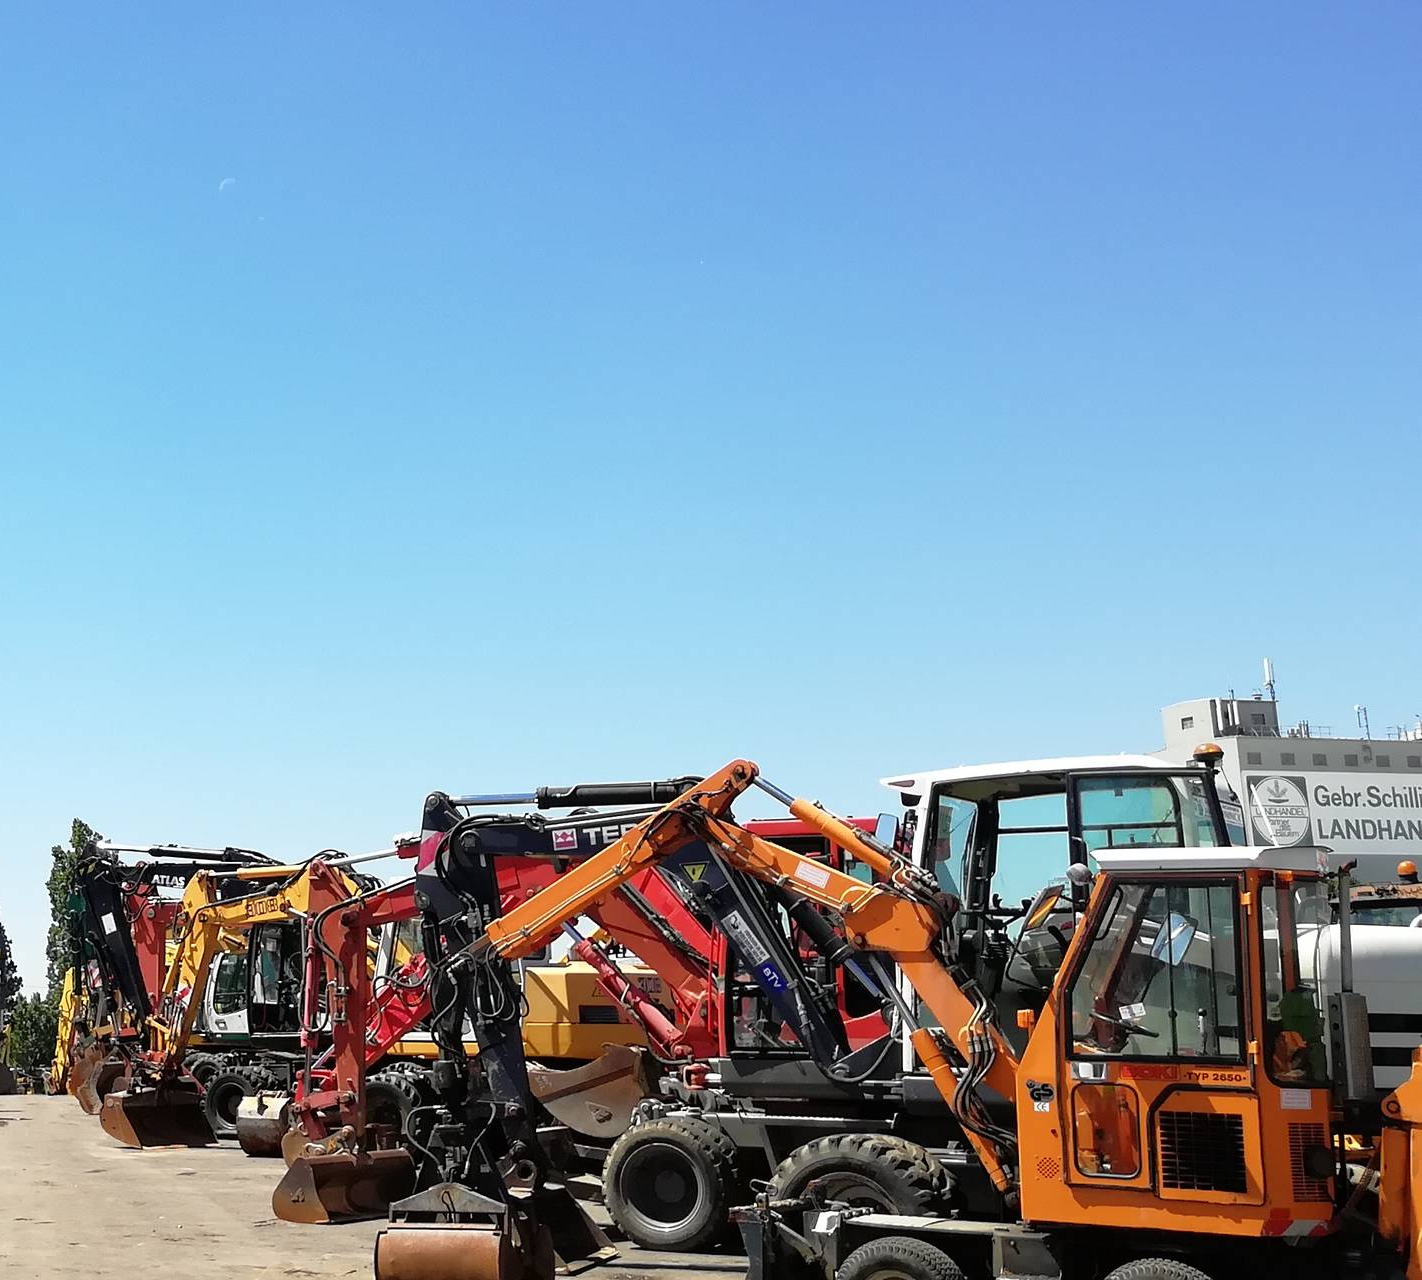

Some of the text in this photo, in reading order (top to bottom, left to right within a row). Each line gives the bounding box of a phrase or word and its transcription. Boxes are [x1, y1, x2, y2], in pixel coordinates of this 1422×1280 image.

[1255, 807, 1306, 816] LNDHANDEL
[1317, 818, 1422, 840] LANDHAN
[152, 874, 186, 886] ATLAS
